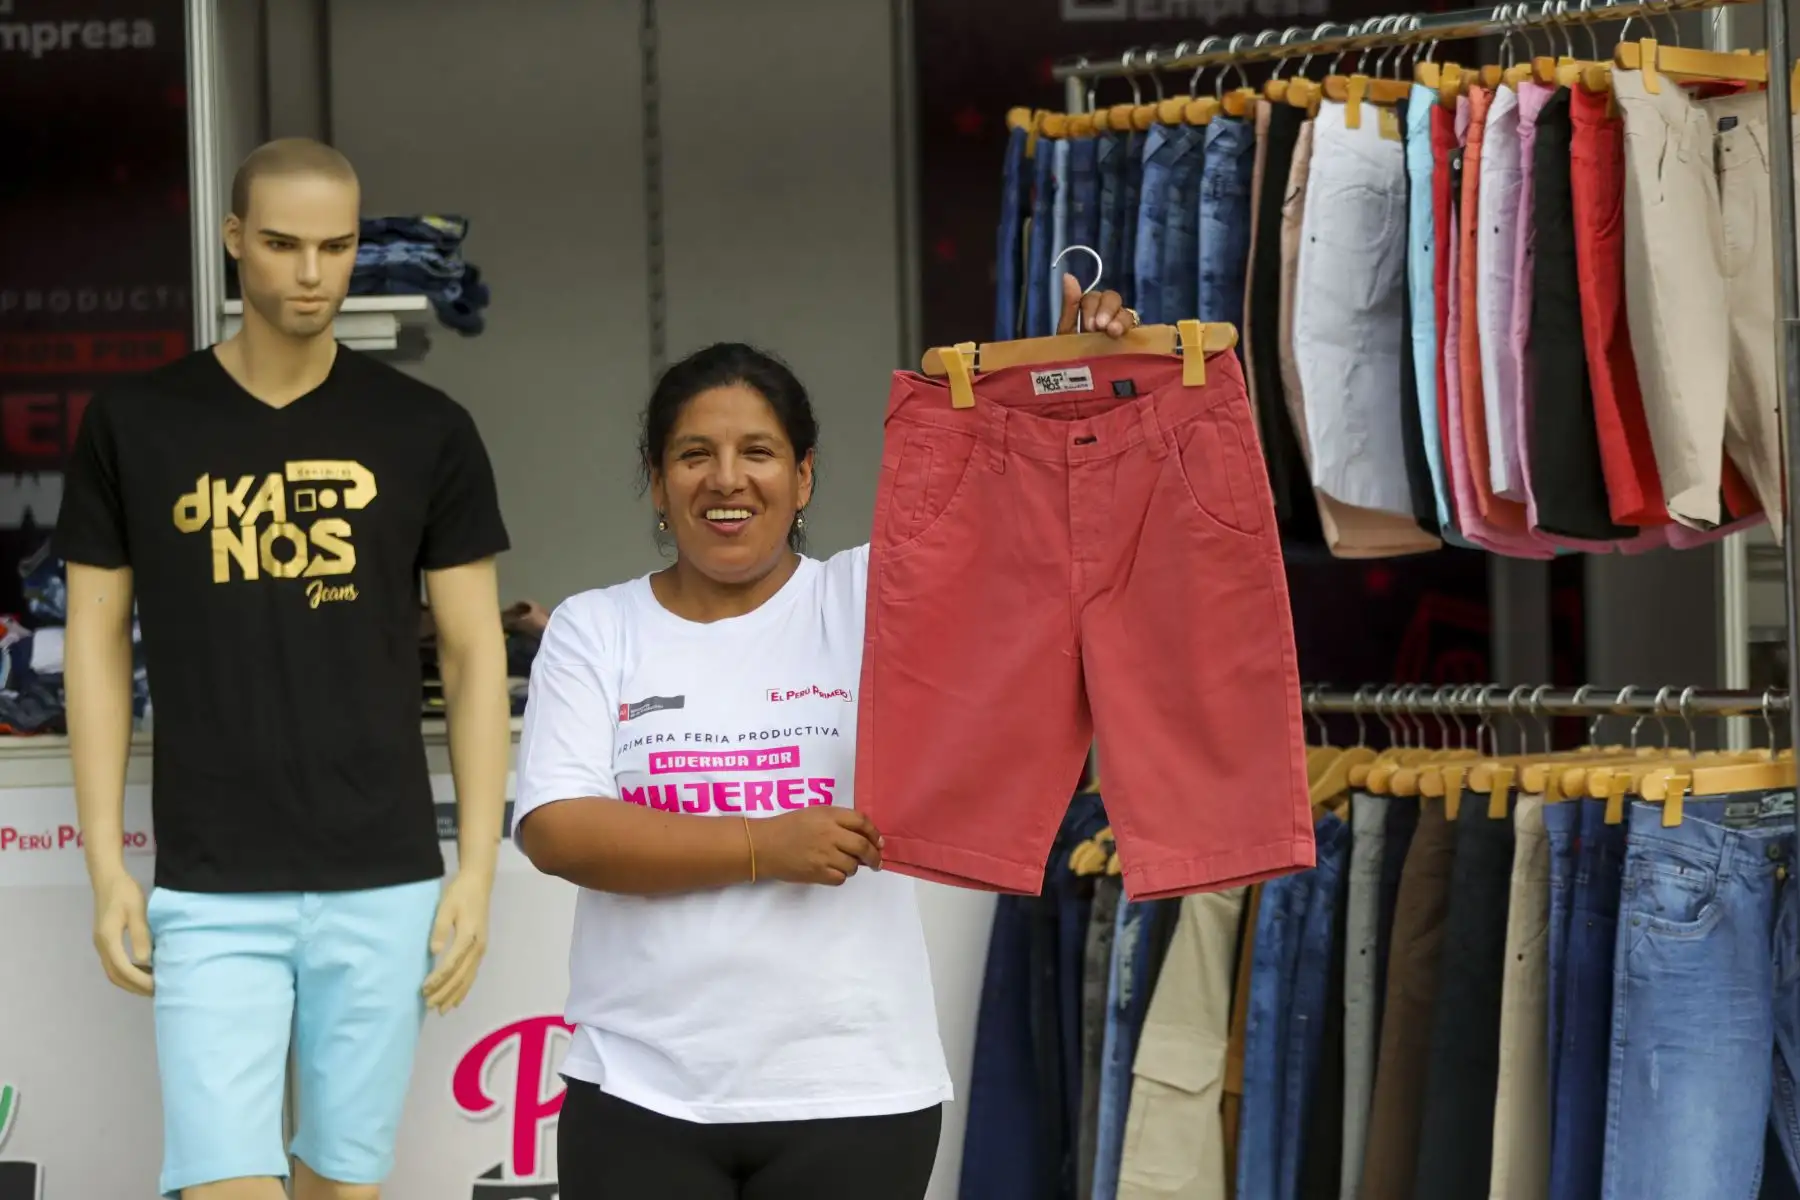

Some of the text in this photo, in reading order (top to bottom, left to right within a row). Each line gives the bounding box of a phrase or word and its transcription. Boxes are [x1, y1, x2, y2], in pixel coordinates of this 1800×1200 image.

[211, 517, 357, 584] NOS
[305, 579, 359, 609] Jeans
[684, 732, 731, 744] FERIA
[738, 725, 840, 743] PRODUCTIVA
[655, 751, 793, 770] LIDERADA POR
[621, 778, 835, 812] MUJERES
